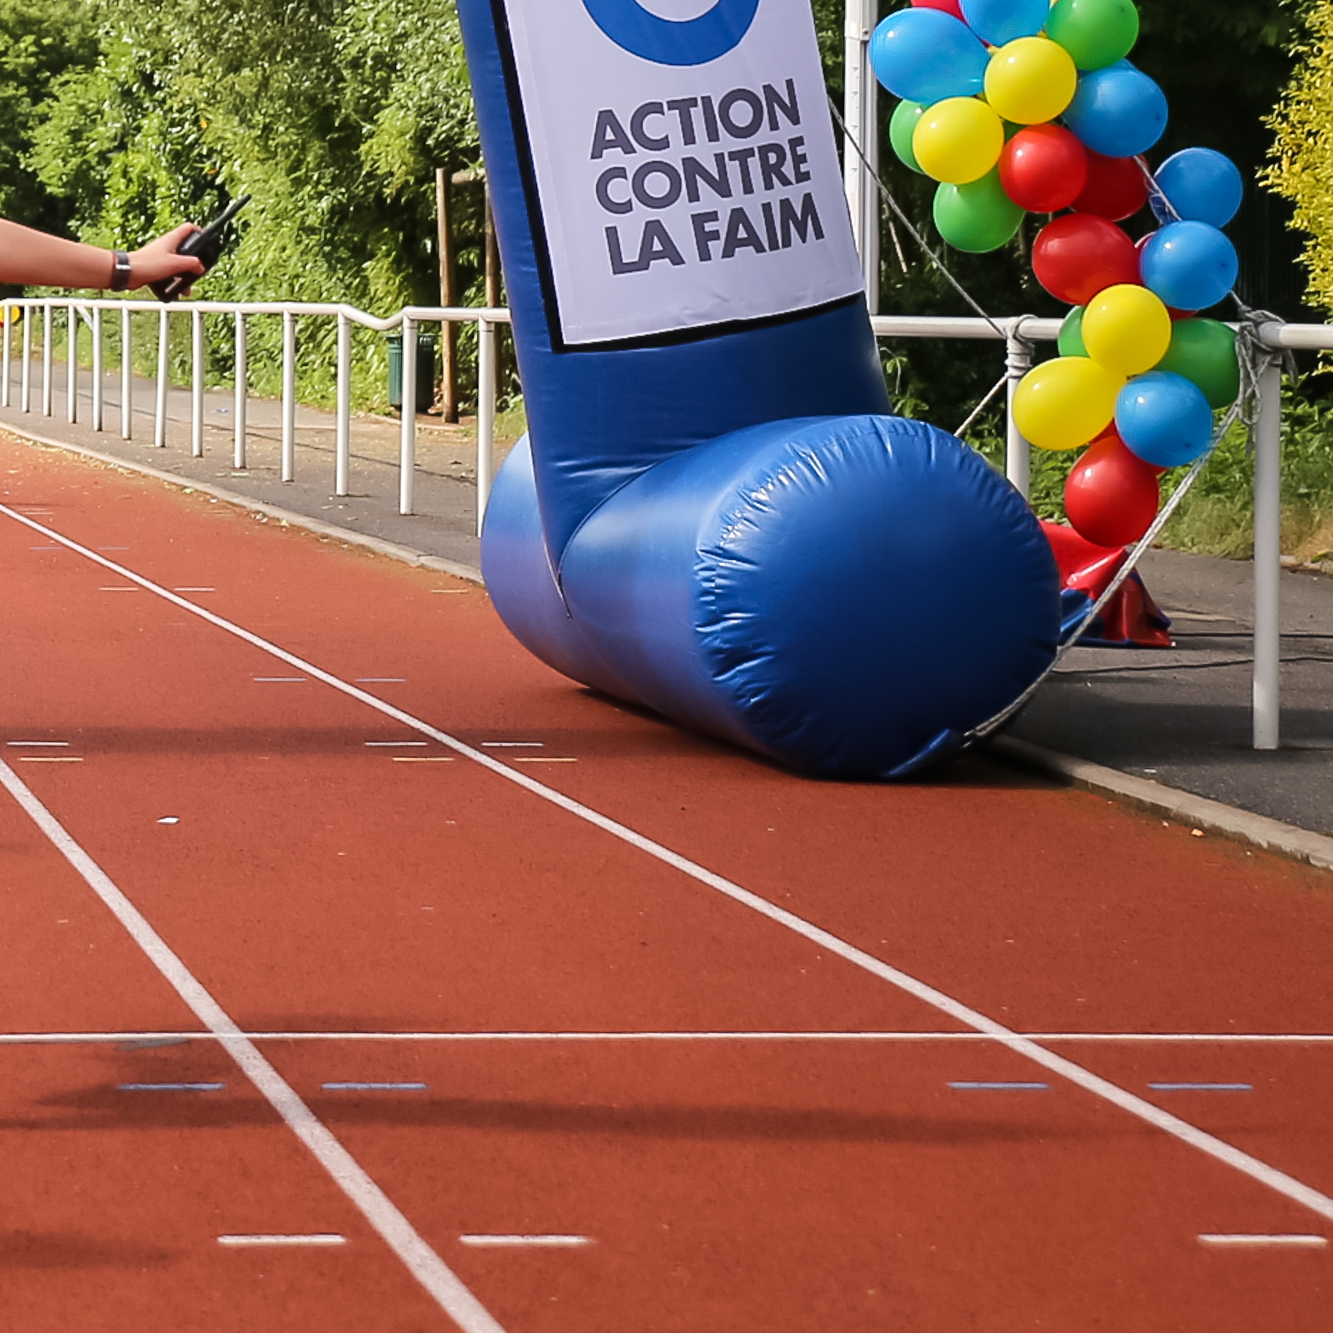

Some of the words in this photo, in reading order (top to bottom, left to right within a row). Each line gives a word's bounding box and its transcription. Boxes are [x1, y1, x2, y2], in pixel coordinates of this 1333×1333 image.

[590, 78, 801, 160] ACTION
[596, 136, 811, 214] CONTRE
[605, 219, 686, 275] LA
[691, 193, 825, 262] FAIM
